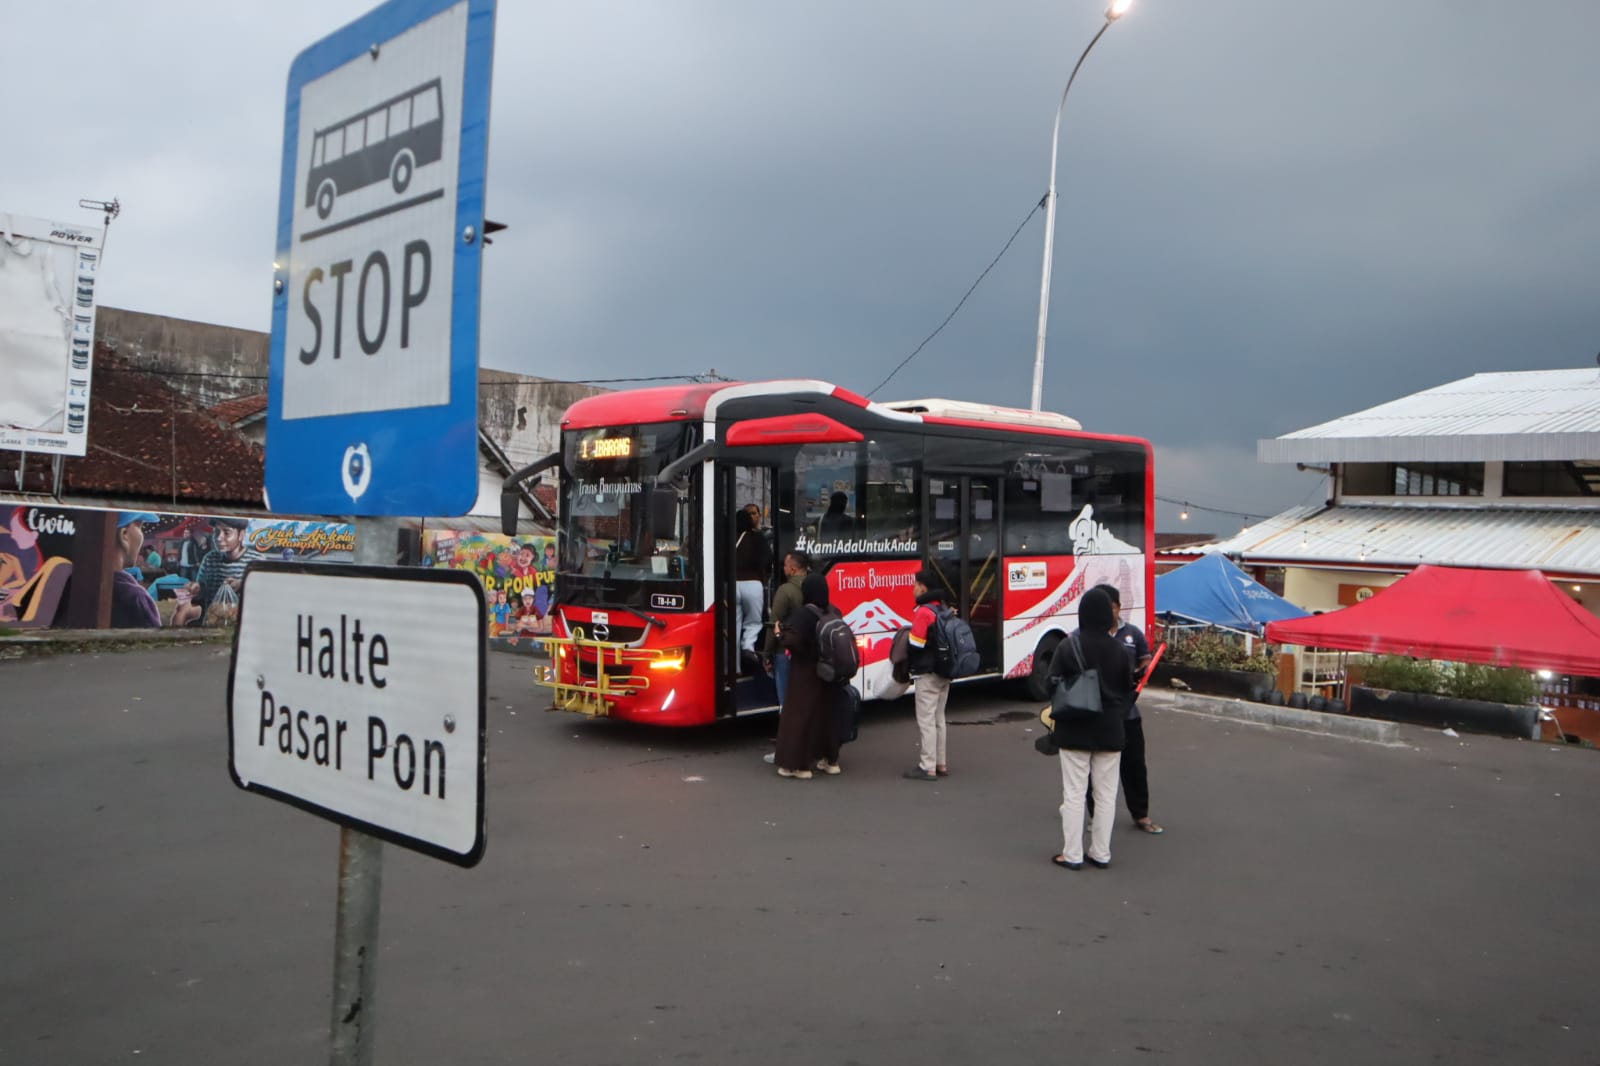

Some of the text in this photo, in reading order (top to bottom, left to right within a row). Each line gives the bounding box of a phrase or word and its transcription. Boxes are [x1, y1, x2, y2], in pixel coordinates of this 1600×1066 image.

[50, 230, 93, 243] POWER
[298, 239, 432, 366] STOP
[578, 476, 642, 498] Trans Banyumas
[28, 507, 76, 536] Livin
[794, 535, 918, 555] #KamiAdaUntukAnda
[503, 575, 534, 594] PON
[835, 567, 915, 592] Trans Banyuma
[297, 613, 389, 689] Halte
[258, 690, 446, 800] Pasar Pon
